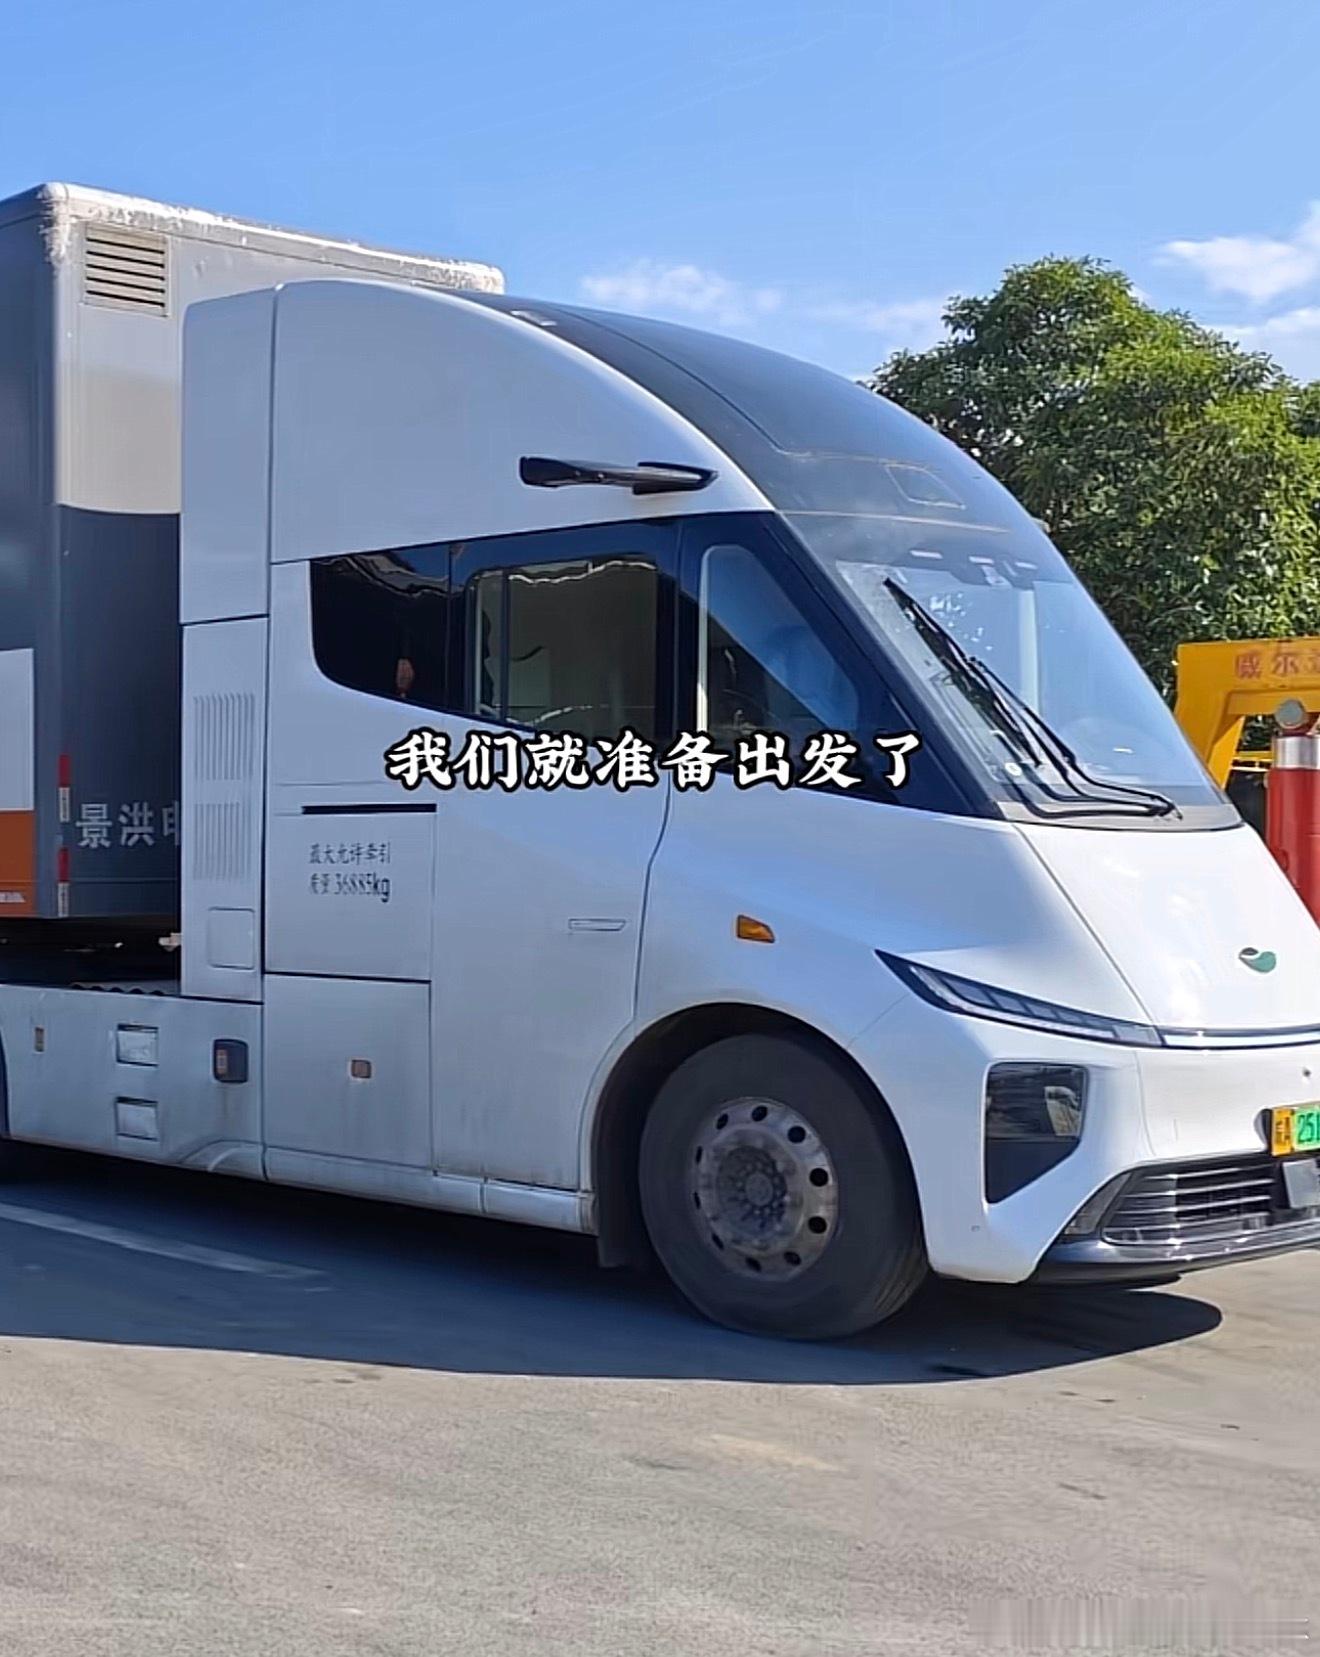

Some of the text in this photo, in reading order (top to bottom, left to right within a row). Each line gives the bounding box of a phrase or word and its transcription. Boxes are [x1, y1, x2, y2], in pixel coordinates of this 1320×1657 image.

[309, 841, 390, 865] 最大允许牵引
